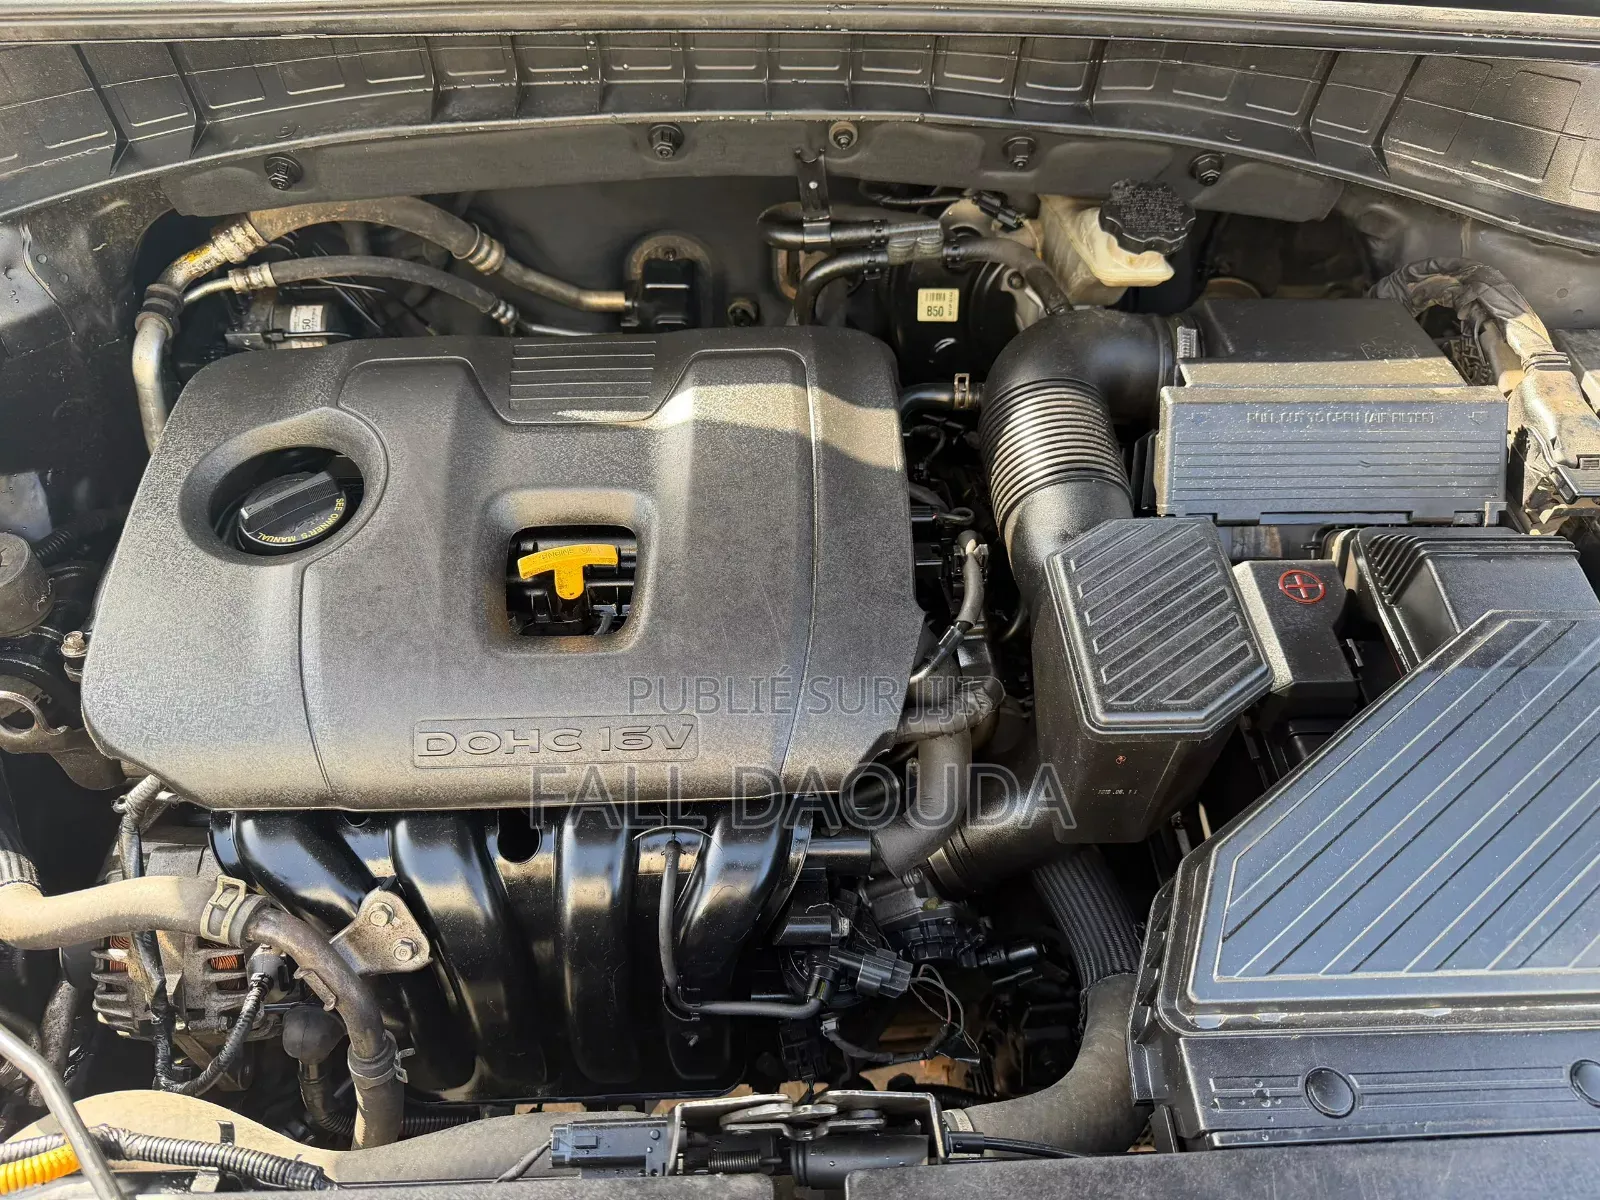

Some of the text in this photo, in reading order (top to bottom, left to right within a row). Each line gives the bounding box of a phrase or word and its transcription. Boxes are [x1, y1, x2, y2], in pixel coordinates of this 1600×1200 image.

[257, 498, 344, 543] SEE OWNER'S MANUAL
[418, 723, 694, 757] DOHC 16V
